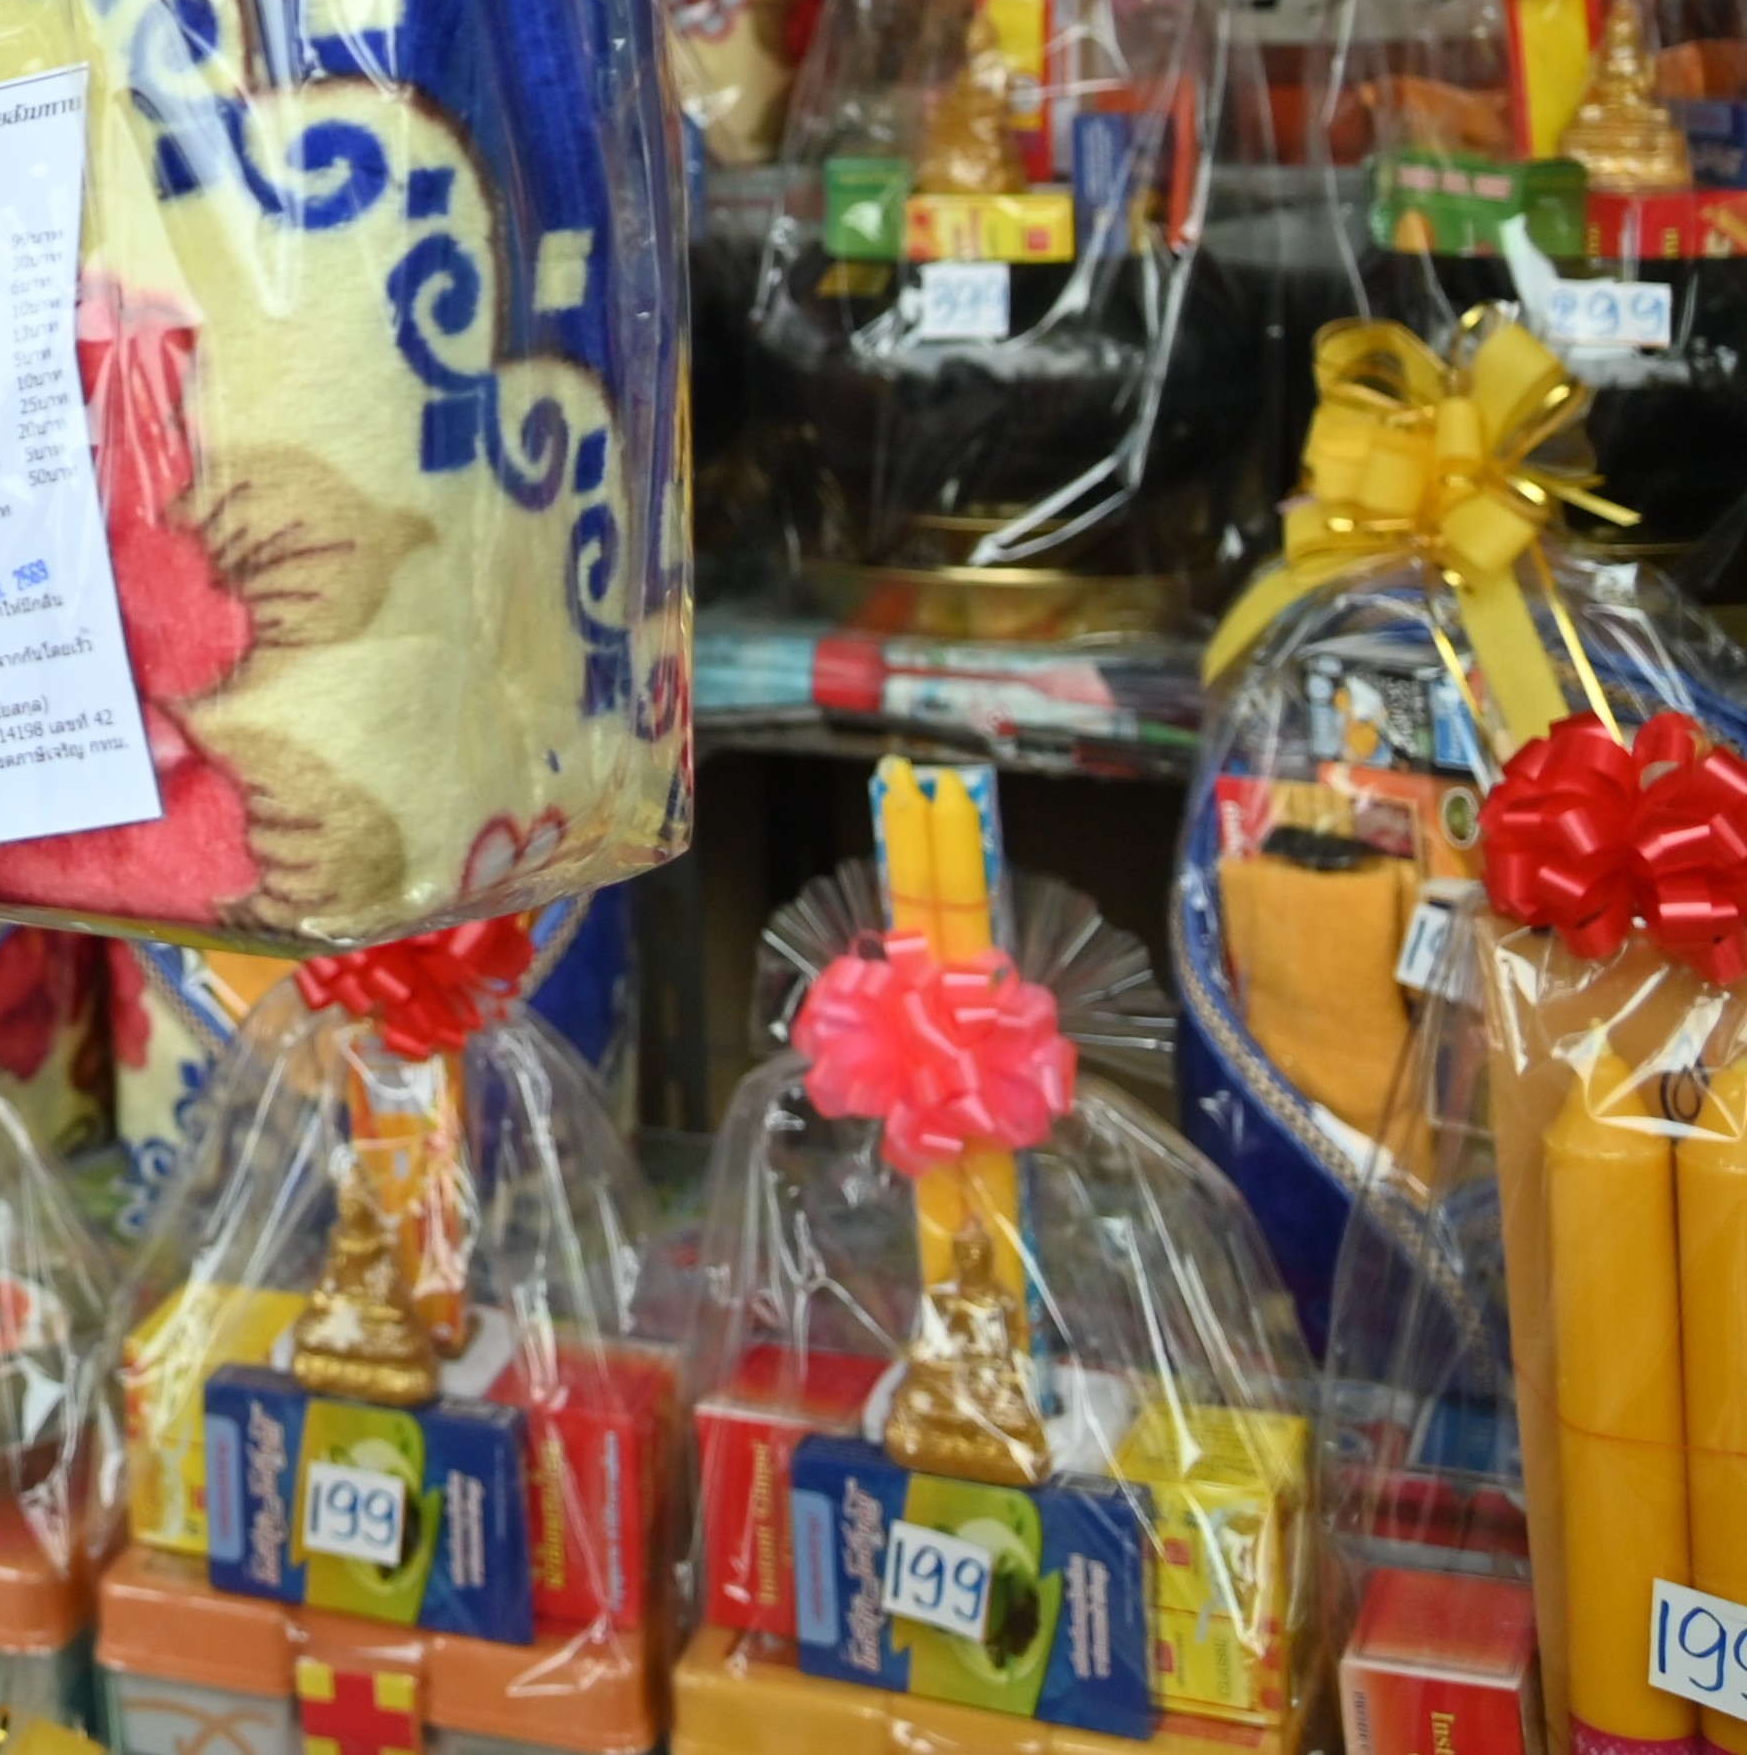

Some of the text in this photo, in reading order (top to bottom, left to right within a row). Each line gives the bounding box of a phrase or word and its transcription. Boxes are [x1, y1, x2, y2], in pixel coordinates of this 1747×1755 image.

[92, 708, 114, 726] 42
[309, 1479, 400, 1549] 199
[891, 1536, 989, 1623] 199
[1657, 1597, 1747, 1701] 19
